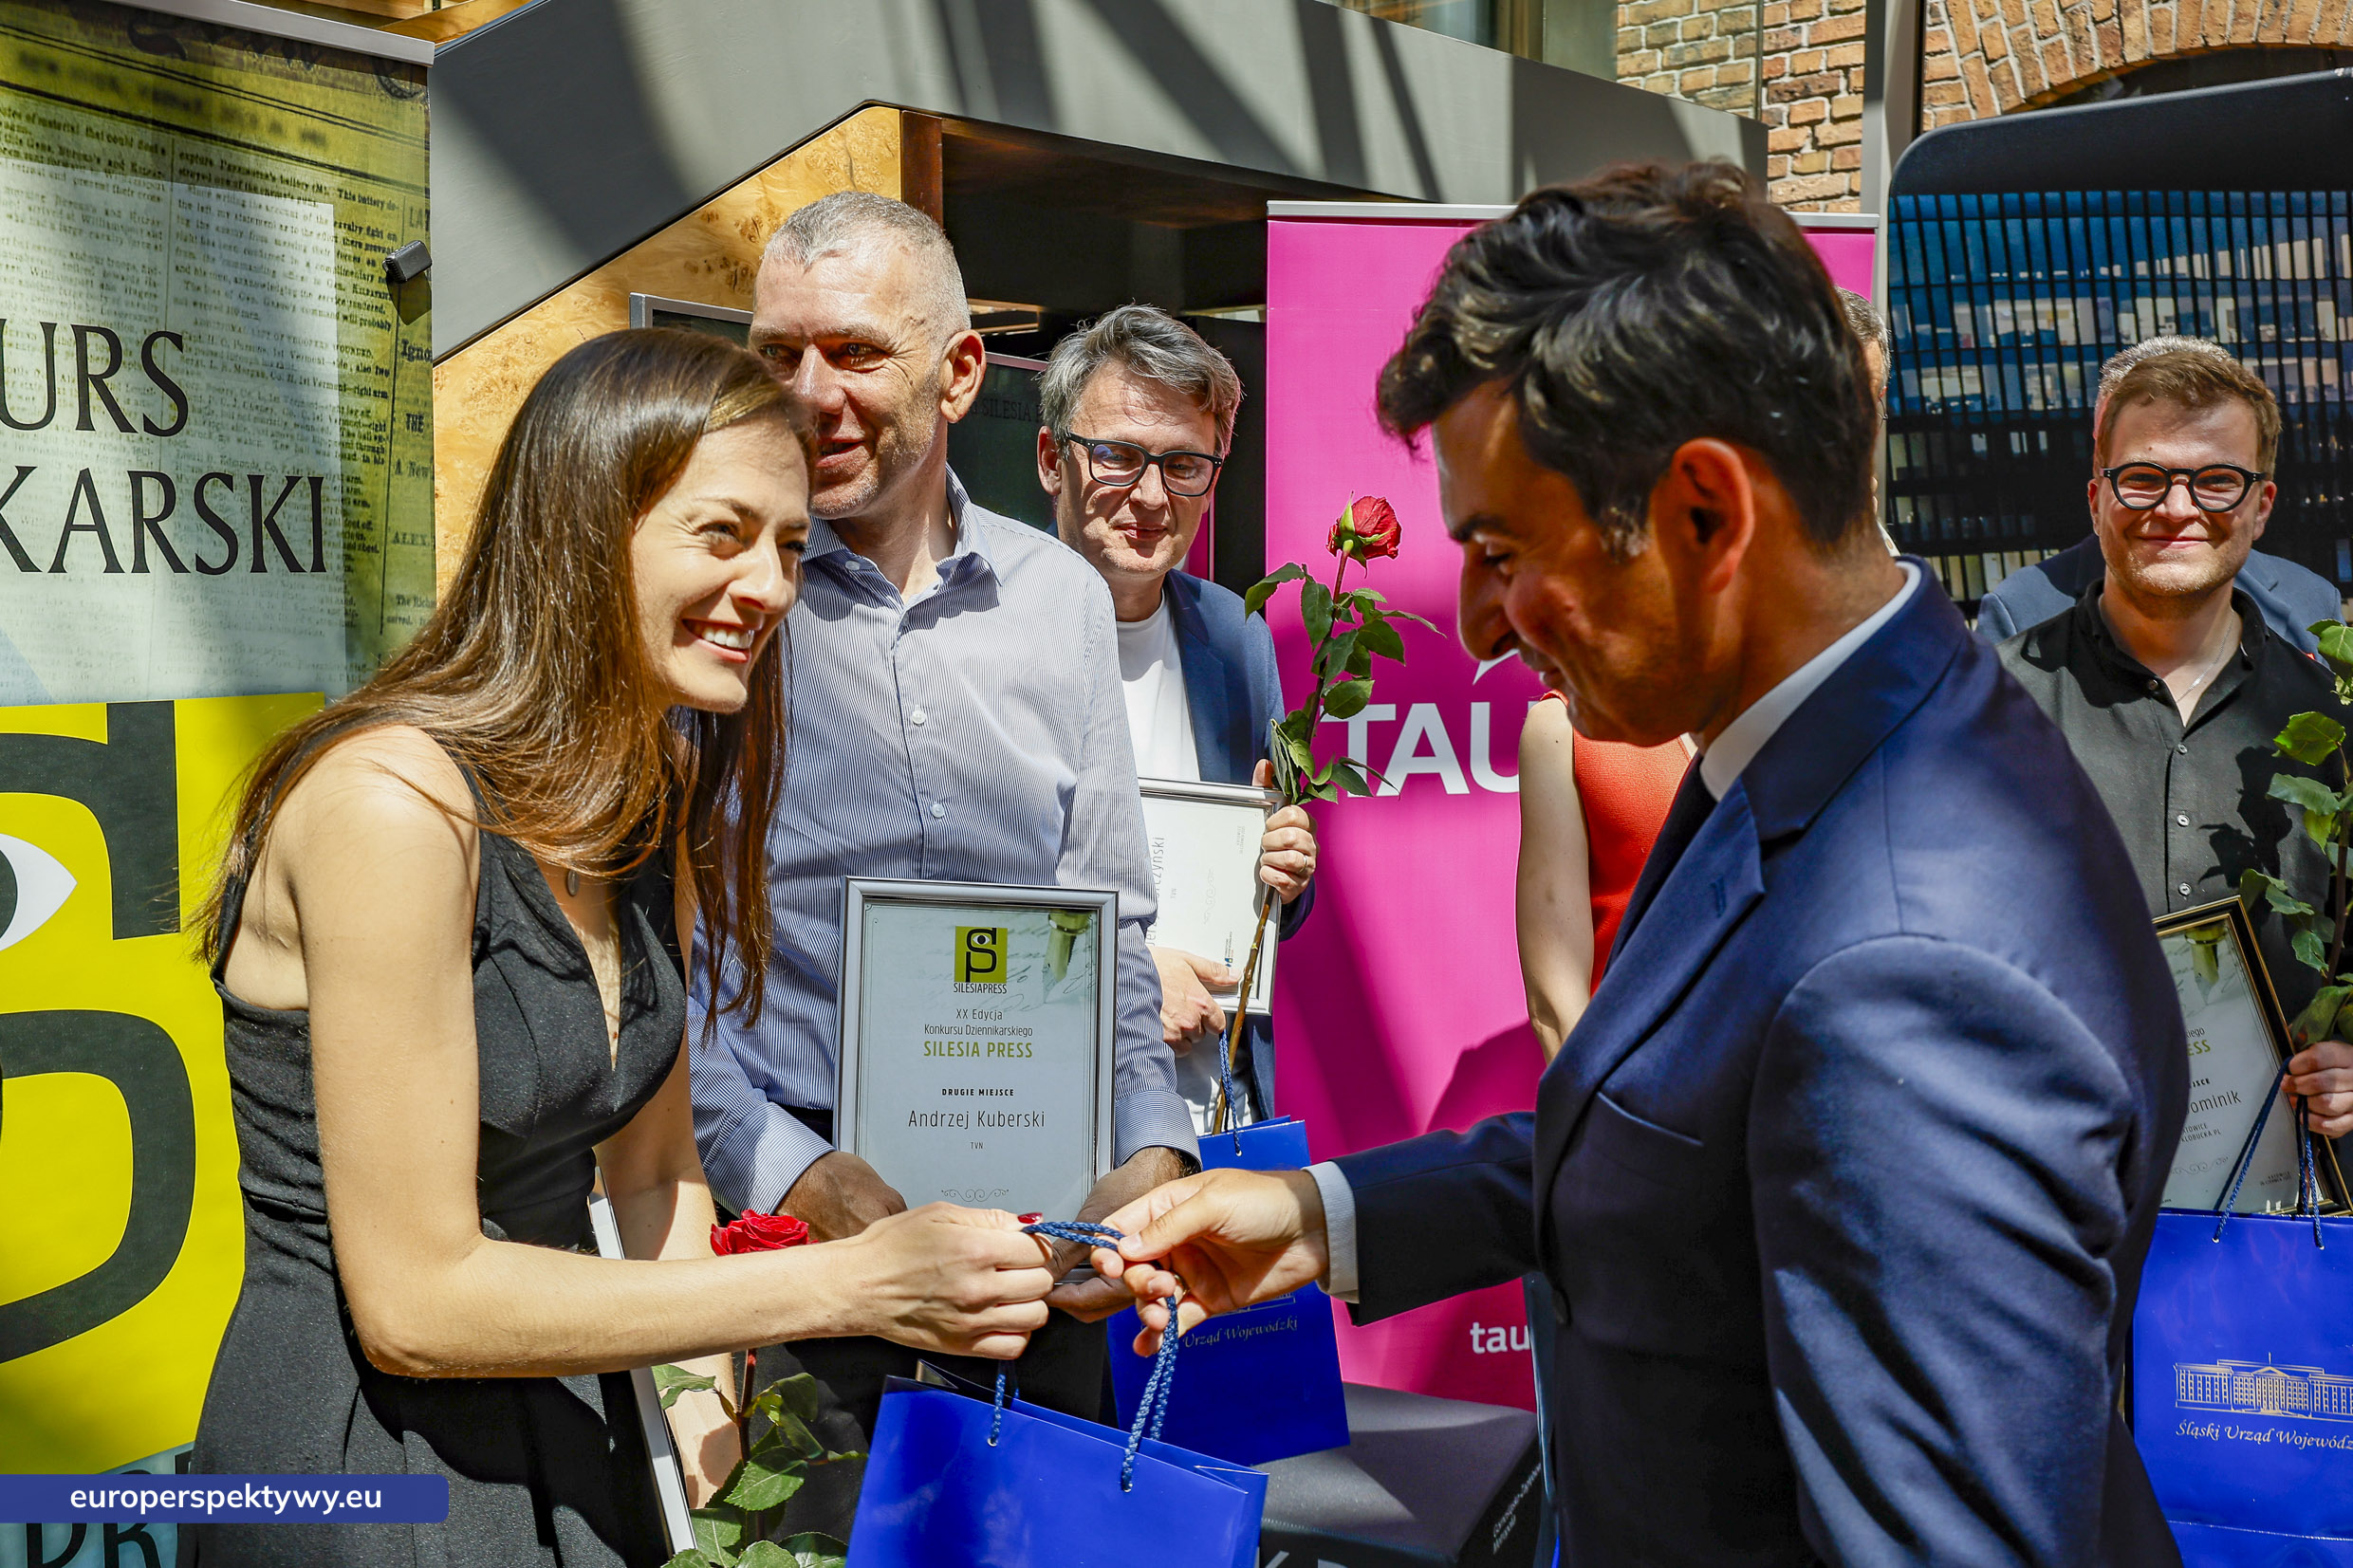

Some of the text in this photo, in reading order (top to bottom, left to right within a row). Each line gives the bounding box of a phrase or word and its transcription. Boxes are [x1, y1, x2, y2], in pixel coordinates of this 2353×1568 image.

[953, 981, 1009, 995] SILESIAPRESS
[955, 1008, 1004, 1023] XX Edycja
[923, 1024, 1034, 1039] Konkursu Dziennikarskiego
[923, 1041, 1034, 1060] SILESIA PRESS
[941, 1088, 1015, 1098] DRUGIE MIEJSCE
[2185, 1089, 2242, 1115] ominik
[908, 1109, 1047, 1131] Andrzej Kuberski
[970, 1141, 985, 1151] TVN
[1181, 1317, 1299, 1351] Urząd Wojewódzki
[2176, 1418, 2221, 1442] Śląski
[2224, 1425, 2273, 1444] Urząd
